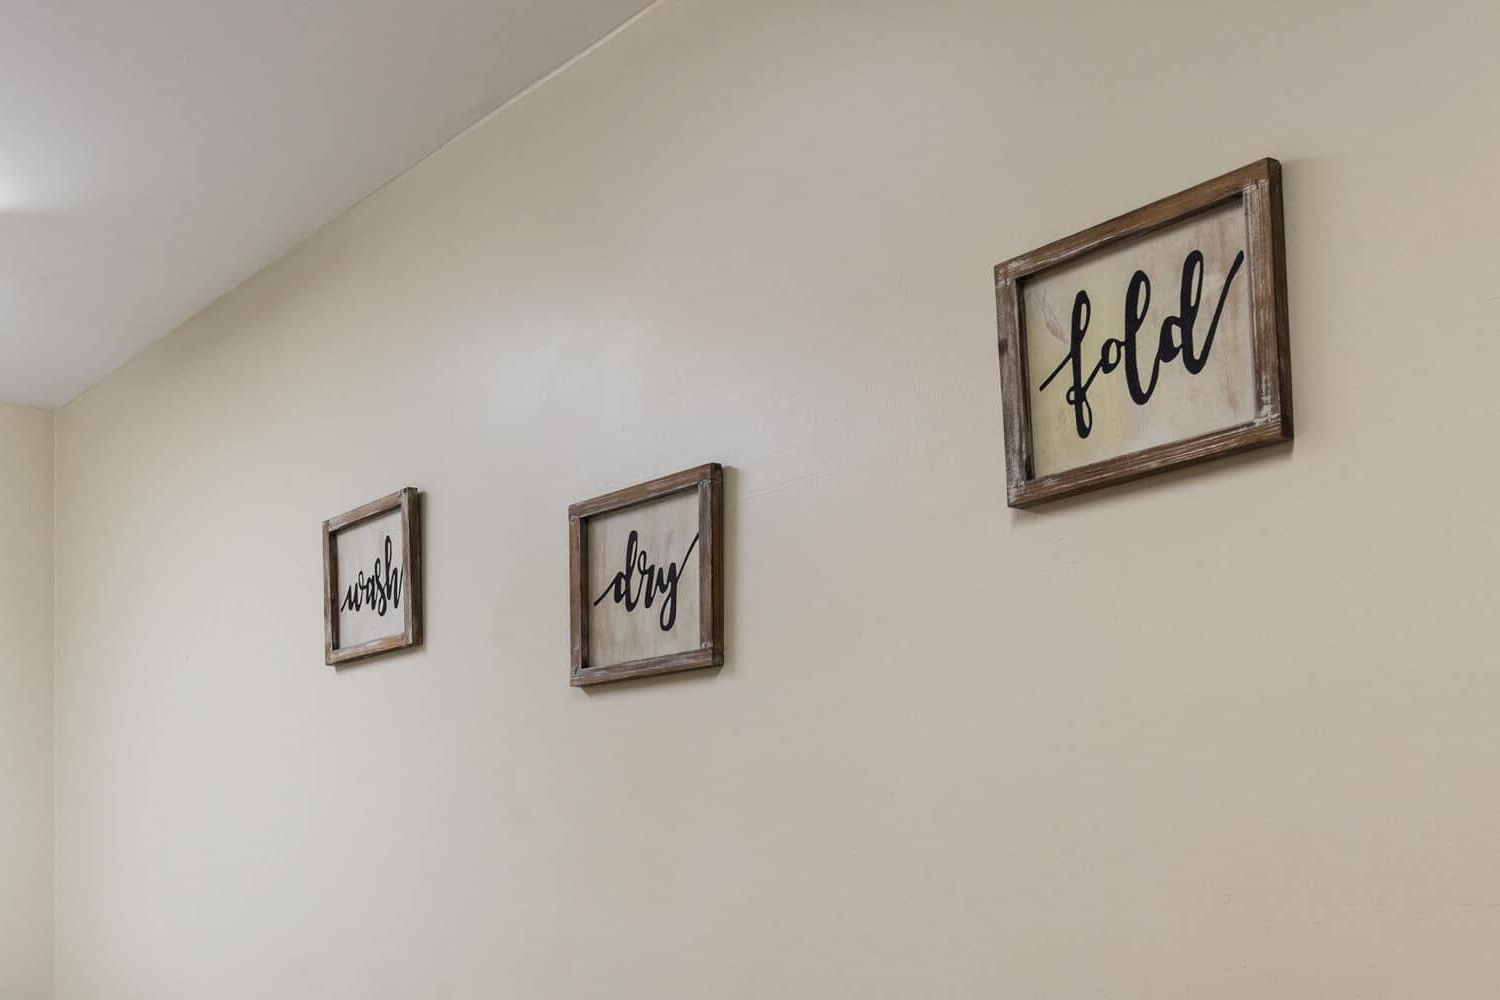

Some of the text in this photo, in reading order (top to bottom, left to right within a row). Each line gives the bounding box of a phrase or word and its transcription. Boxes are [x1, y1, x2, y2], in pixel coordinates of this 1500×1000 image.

[1039, 250, 1245, 439] fold
[340, 535, 404, 617] wash
[594, 530, 699, 632] dry
